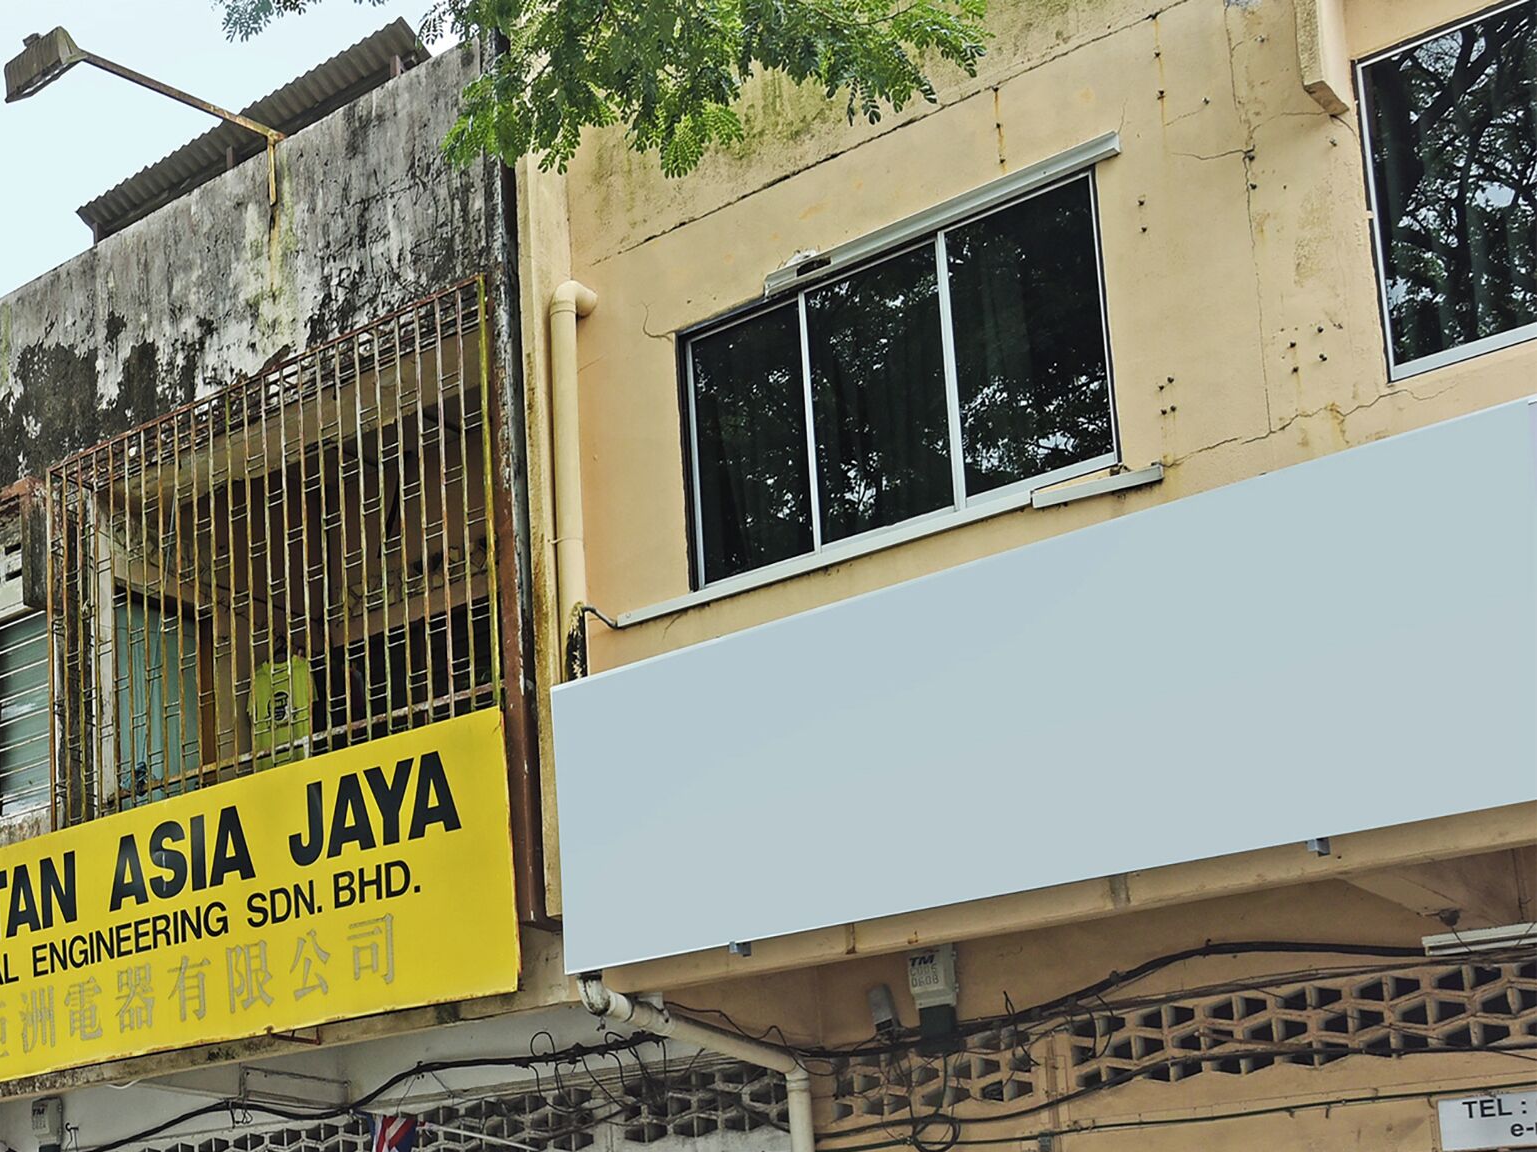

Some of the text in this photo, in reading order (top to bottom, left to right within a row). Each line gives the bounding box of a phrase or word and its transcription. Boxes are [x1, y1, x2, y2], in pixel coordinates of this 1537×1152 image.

[109, 805, 256, 912] ASIA
[289, 750, 462, 866] JAYA
[32, 901, 229, 978] ENGINEERING
[247, 880, 322, 927] SDN.
[333, 860, 421, 909] BHD.
[910, 954, 935, 967] TM
[1462, 1098, 1513, 1118] TEL
[1510, 1122, 1537, 1137] e-
